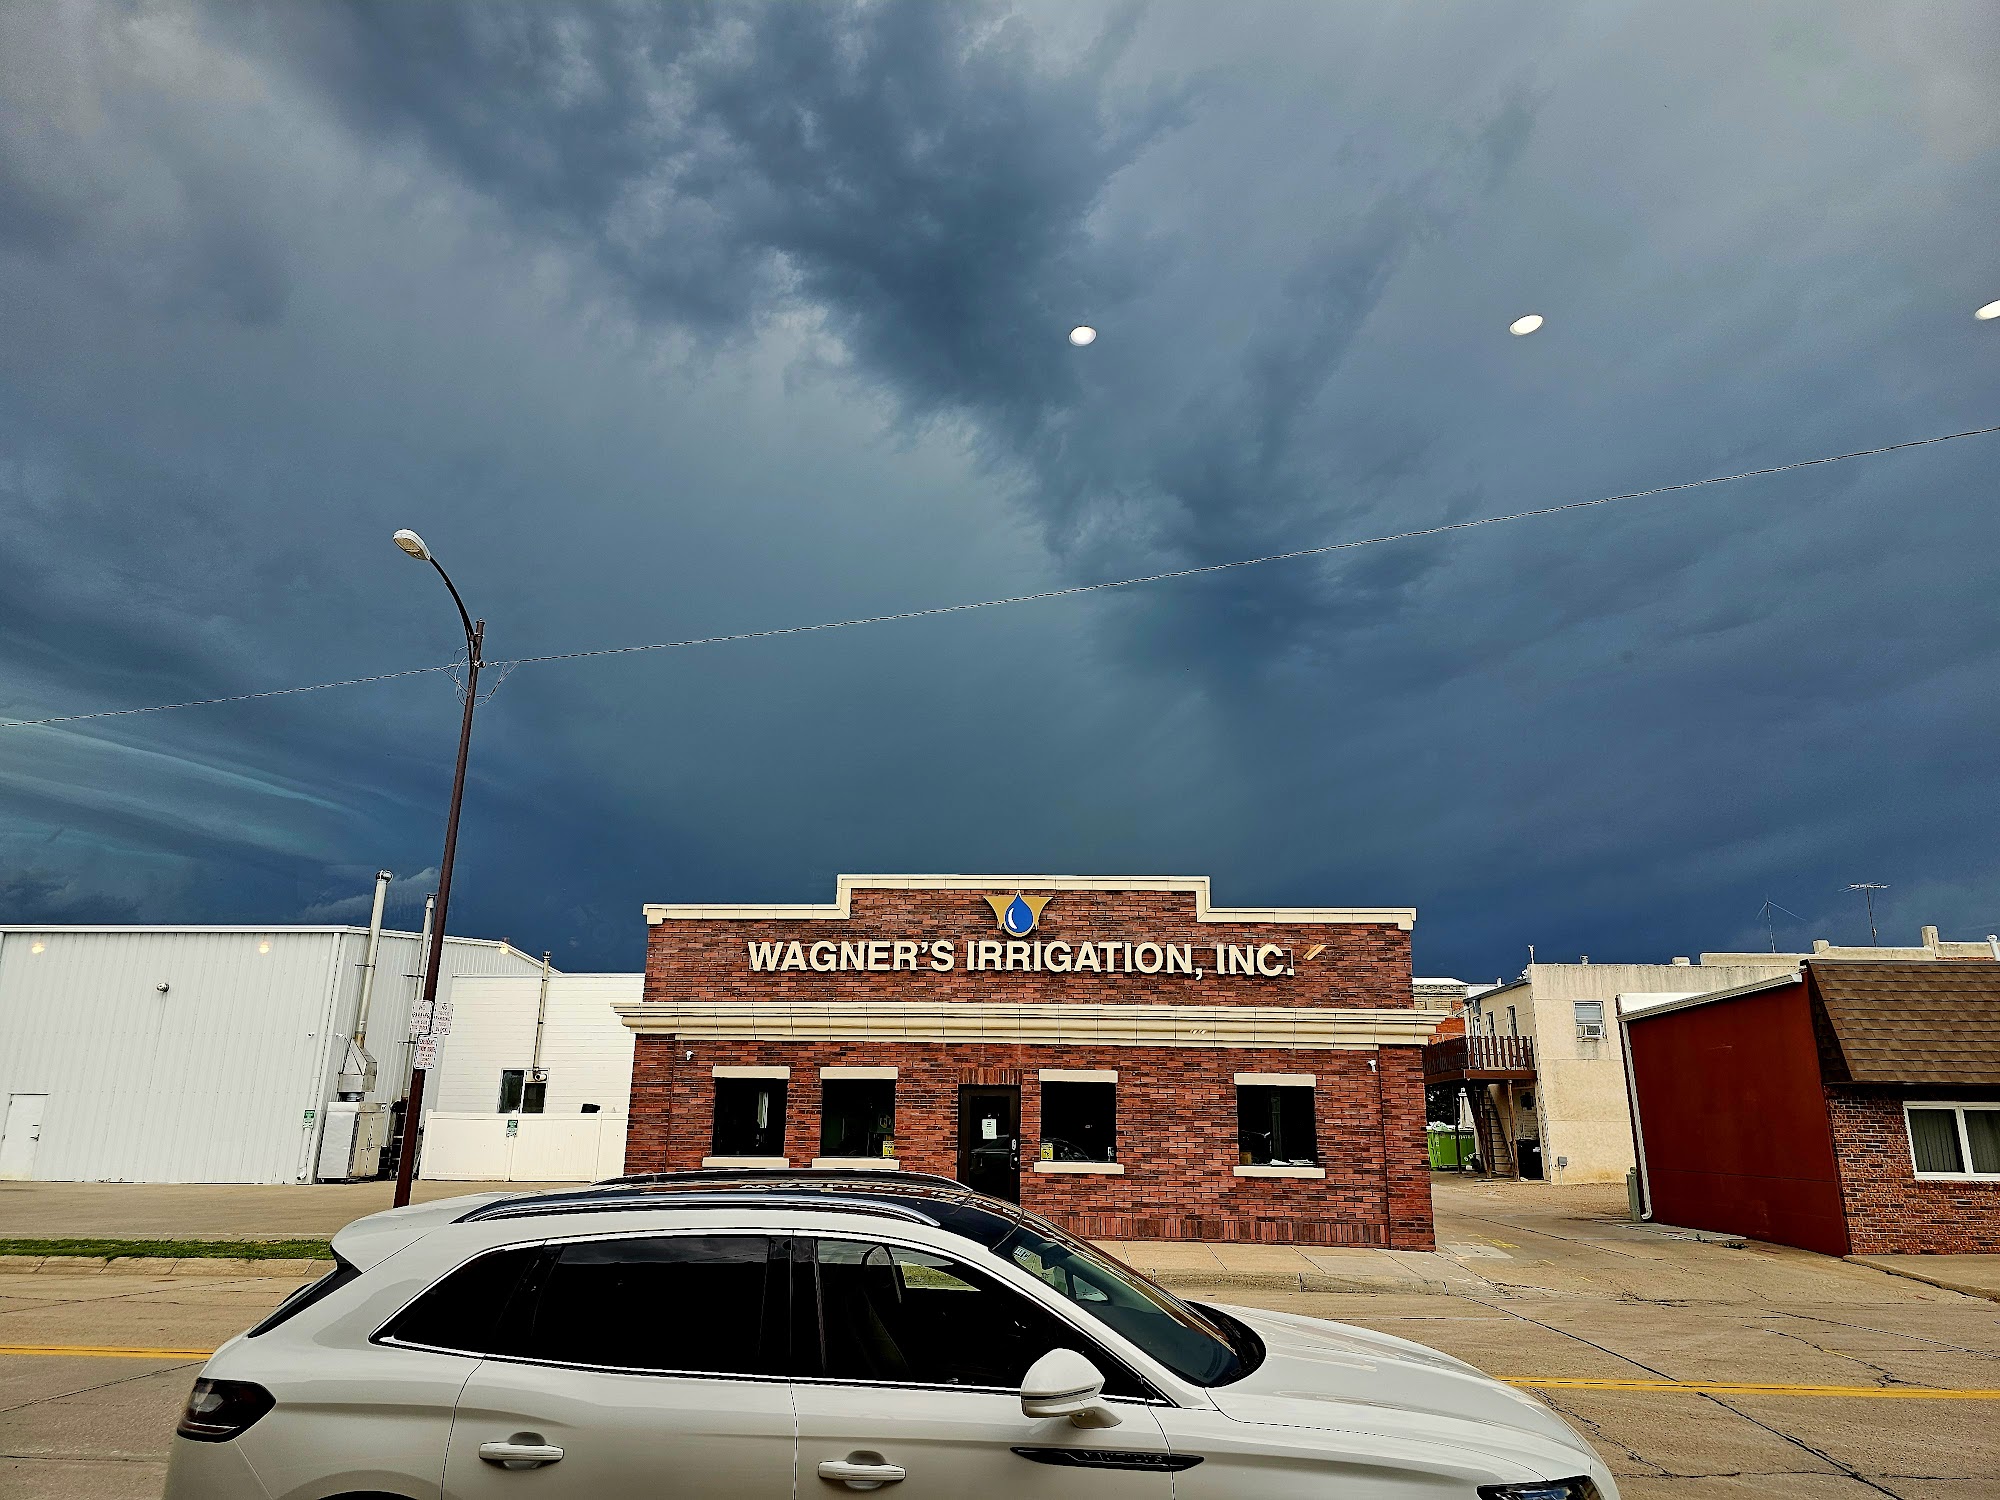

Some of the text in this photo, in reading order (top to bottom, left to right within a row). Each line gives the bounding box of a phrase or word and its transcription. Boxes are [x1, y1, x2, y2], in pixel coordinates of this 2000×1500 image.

[747, 940, 1295, 981] WAGNER'S IRRIGATION, INC.
